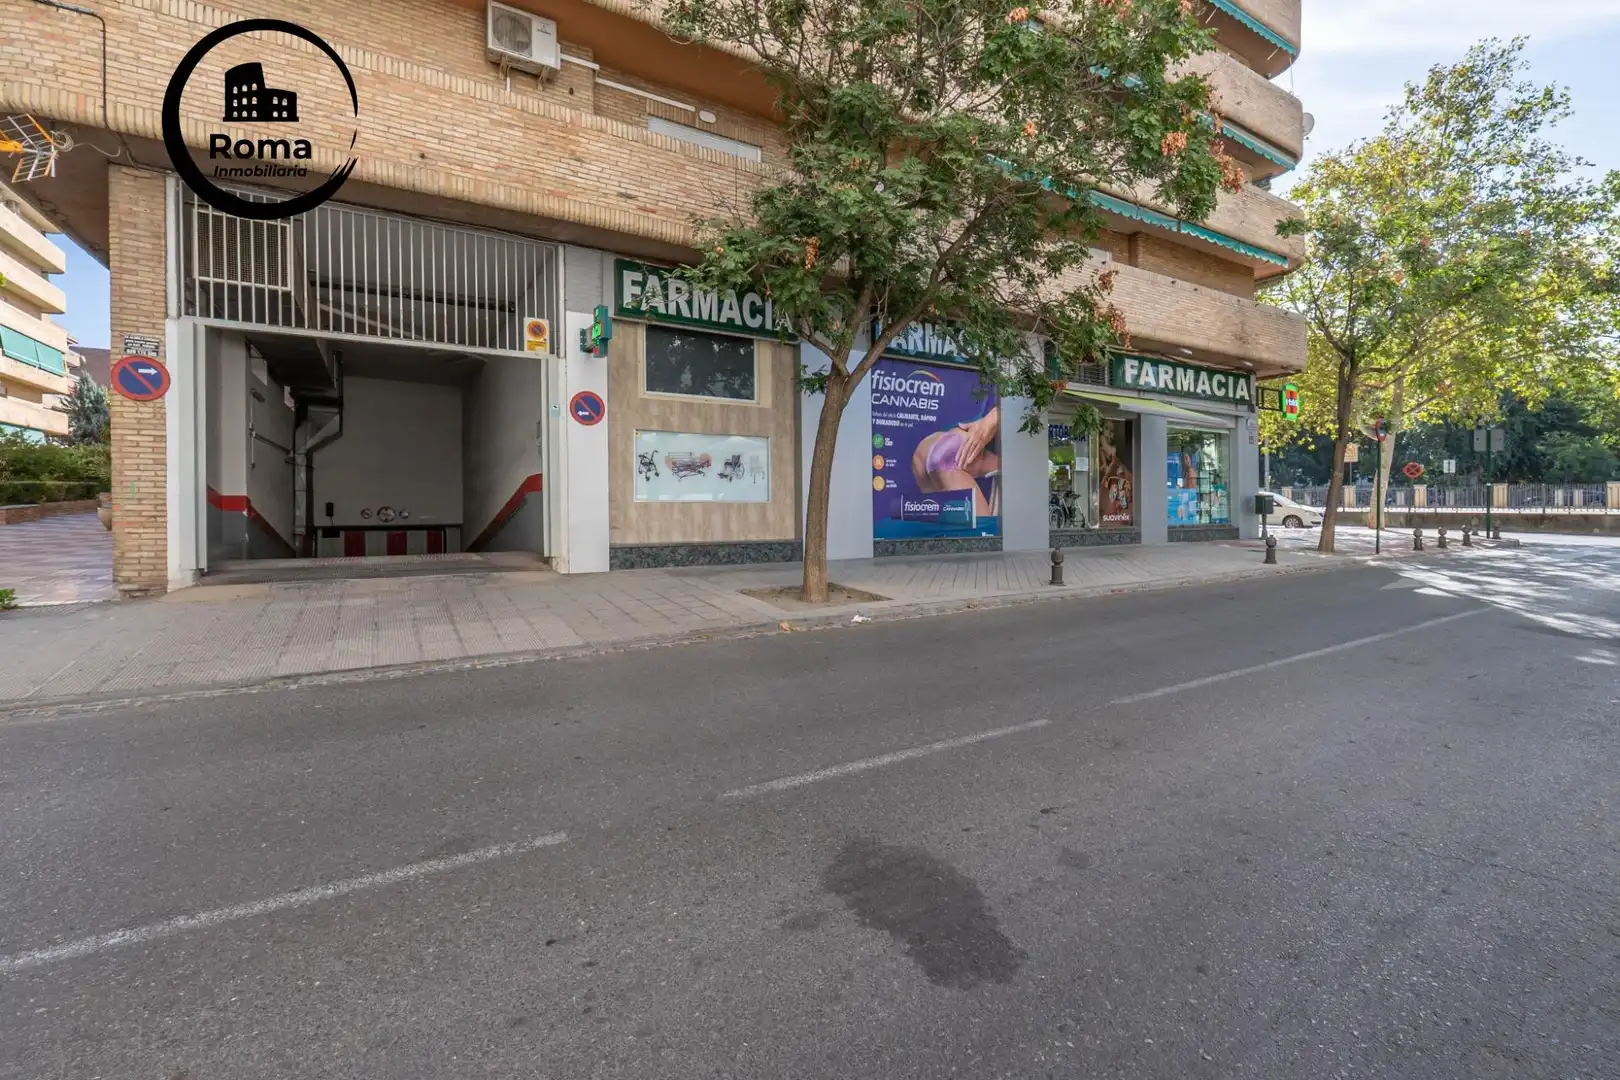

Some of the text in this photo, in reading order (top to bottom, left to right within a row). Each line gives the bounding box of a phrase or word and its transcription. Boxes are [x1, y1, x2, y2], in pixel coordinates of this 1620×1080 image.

[622, 269, 793, 334] FARMACIA
[871, 369, 946, 397] fisiocrem
[1124, 358, 1250, 400] FARMACIA
[871, 393, 939, 410] CANNABIS
[904, 501, 940, 512] fisiocrem
